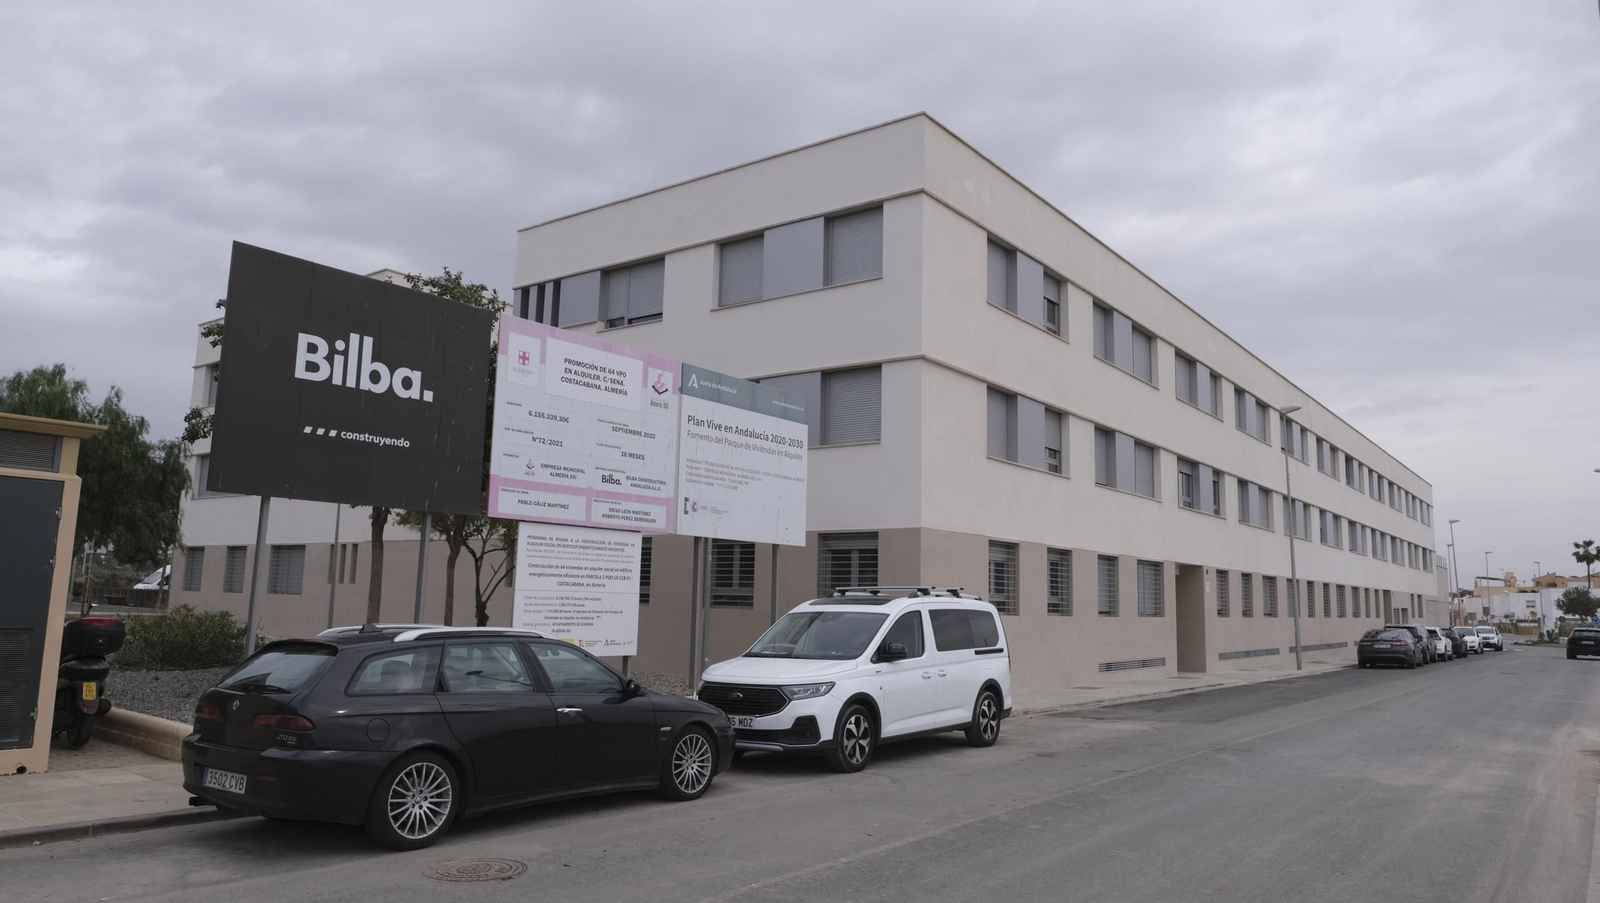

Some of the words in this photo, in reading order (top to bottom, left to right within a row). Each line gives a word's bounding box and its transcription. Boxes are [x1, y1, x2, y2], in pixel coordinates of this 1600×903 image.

[294, 332, 434, 403] Bilba.
[564, 357, 598, 371] PROMOCIÓN
[616, 370, 627, 378] VPO
[604, 384, 628, 396] ALMERÍA
[700, 379, 711, 388] Junta
[718, 384, 737, 395] Andalucía
[528, 410, 570, 424] 6.155.339,30€
[340, 430, 410, 448] construyendo
[612, 426, 643, 437] SEPTIEMBRE
[687, 414, 705, 428] Plan
[706, 419, 722, 432] Vive
[724, 425, 733, 434] en
[735, 424, 769, 442] Andalucía
[770, 433, 804, 449] 2020-2030
[687, 430, 713, 443] Fomento
[714, 435, 723, 445] del
[725, 438, 744, 450] Parque
[744, 442, 751, 450] de
[752, 443, 776, 455] Viviendas
[628, 452, 645, 460] MESES
[601, 473, 623, 486] Bilba.
[738, 718, 753, 727] MDZ
[208, 771, 228, 787] 3502
[229, 775, 244, 790] CVB
